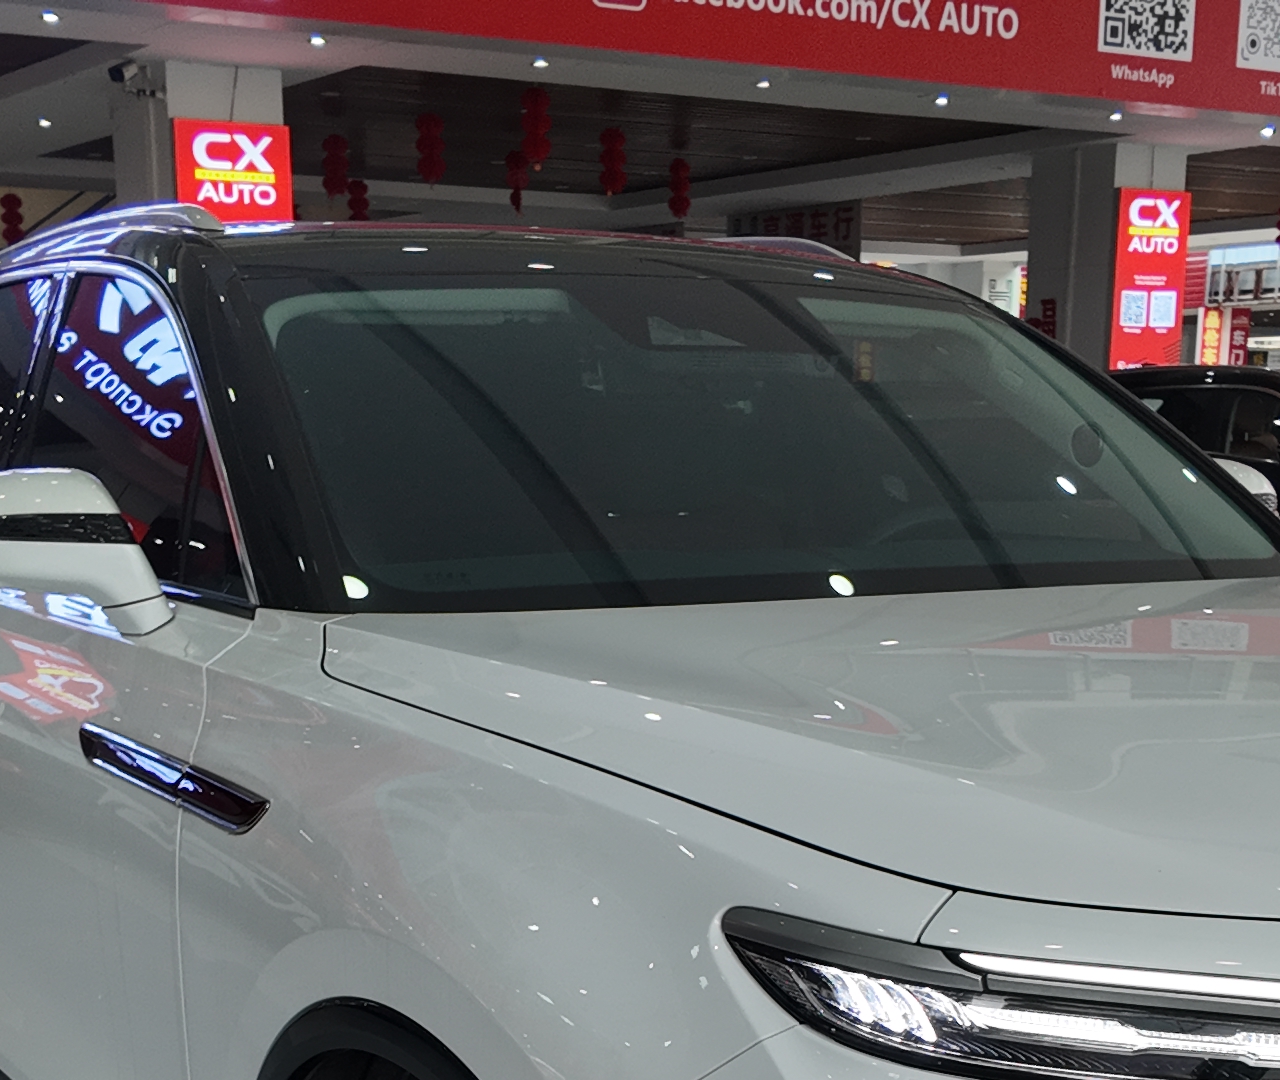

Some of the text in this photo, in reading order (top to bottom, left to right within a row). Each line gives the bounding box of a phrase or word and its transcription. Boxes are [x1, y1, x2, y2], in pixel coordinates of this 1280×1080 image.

[938, 2, 1019, 40] AUTO
[1111, 64, 1175, 89] WhatsApp
[192, 132, 274, 172] CX
[197, 181, 277, 206] AUTO
[1128, 198, 1181, 228] CX
[1127, 236, 1179, 254] AUTO
